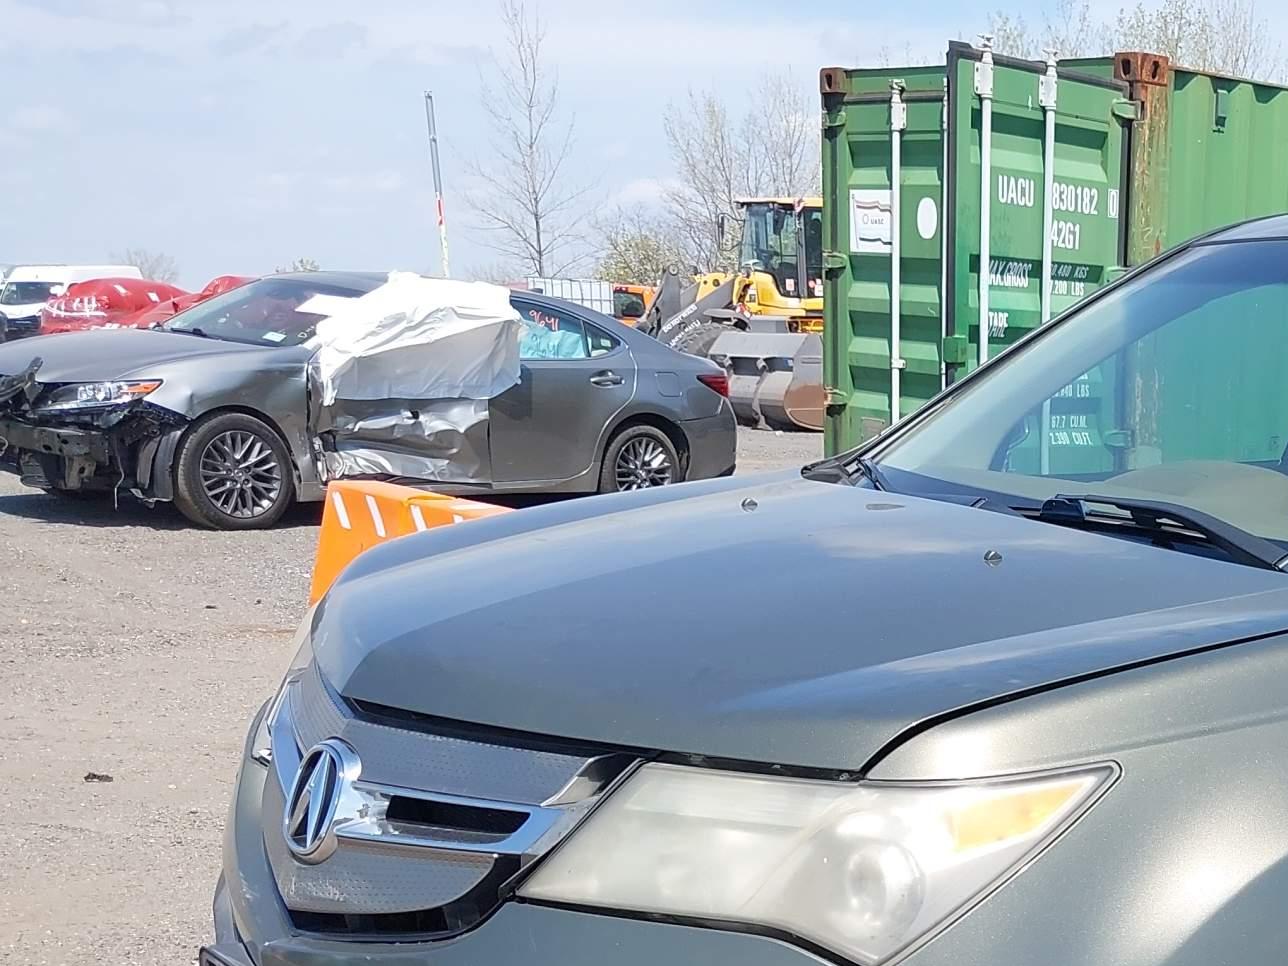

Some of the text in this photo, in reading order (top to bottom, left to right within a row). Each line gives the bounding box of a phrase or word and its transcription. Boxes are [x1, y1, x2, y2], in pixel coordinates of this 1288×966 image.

[999, 174, 1034, 207] UACU
[1052, 182, 1098, 215] 830182
[1050, 220, 1080, 250] 42G1
[1071, 281, 1084, 296] LBS
[529, 309, 560, 331] 9641
[1077, 384, 1090, 397] LBS
[1051, 415, 1066, 428] 67.7
